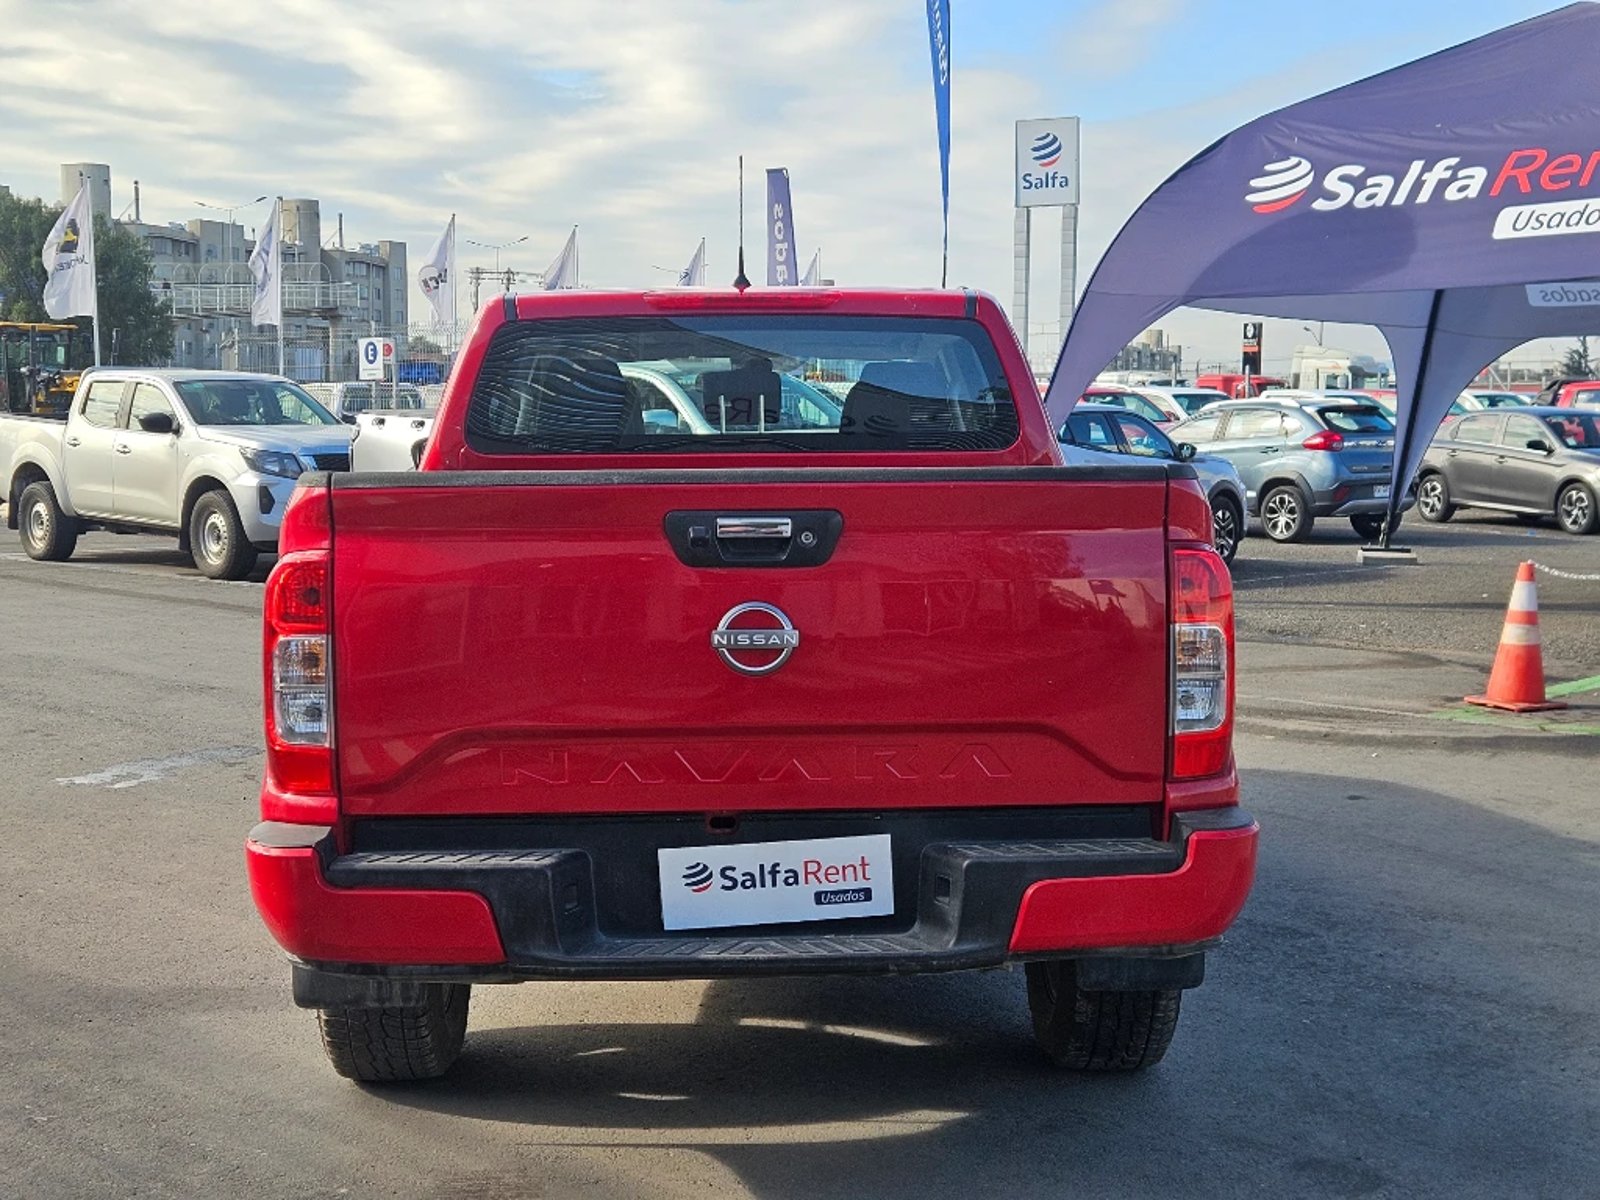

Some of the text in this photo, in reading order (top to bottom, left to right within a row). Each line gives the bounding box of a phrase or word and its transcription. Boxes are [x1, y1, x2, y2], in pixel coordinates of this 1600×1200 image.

[1021, 171, 1069, 191] Salfa
[368, 345, 375, 360] E
[713, 634, 797, 645] NISSAN
[500, 744, 1013, 785] NAVARA
[719, 855, 872, 892] SalfaRent
[820, 890, 865, 904] Usados
